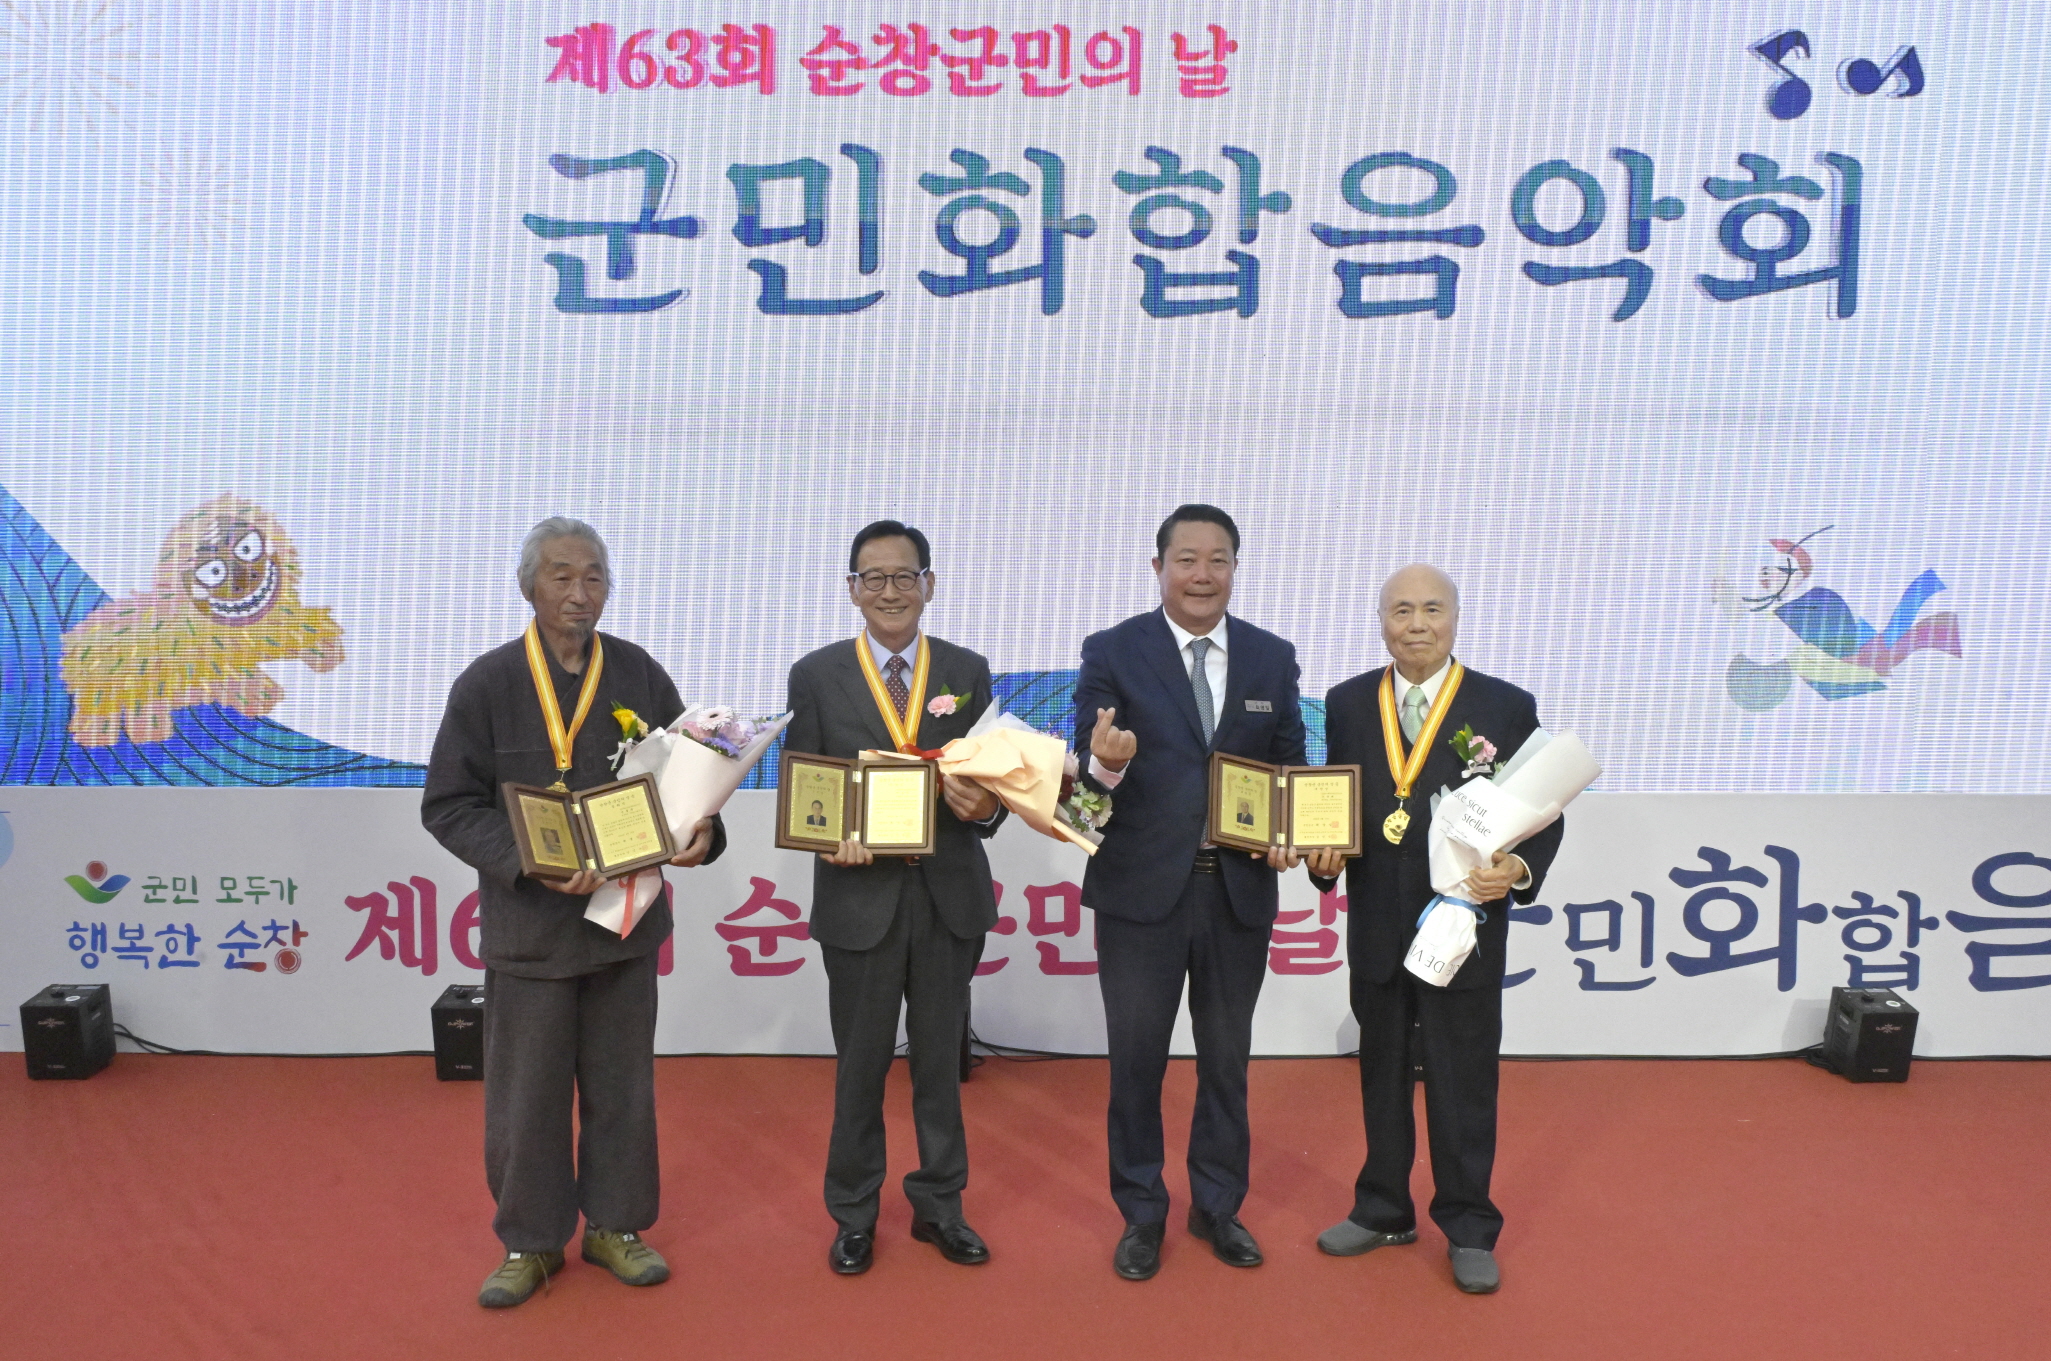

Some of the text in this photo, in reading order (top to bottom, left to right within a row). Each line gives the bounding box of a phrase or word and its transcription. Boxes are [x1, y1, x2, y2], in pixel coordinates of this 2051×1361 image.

[545, 23, 1239, 97] 제63회 순창군민의 날
[523, 143, 1863, 323] 군민화합음악회
[1451, 790, 1488, 818] uce sicut
[1461, 813, 1492, 837] stellae
[141, 874, 299, 906] 군민 모두가
[66, 919, 309, 975] 행복한 순창
[1424, 956, 1446, 974] DE
